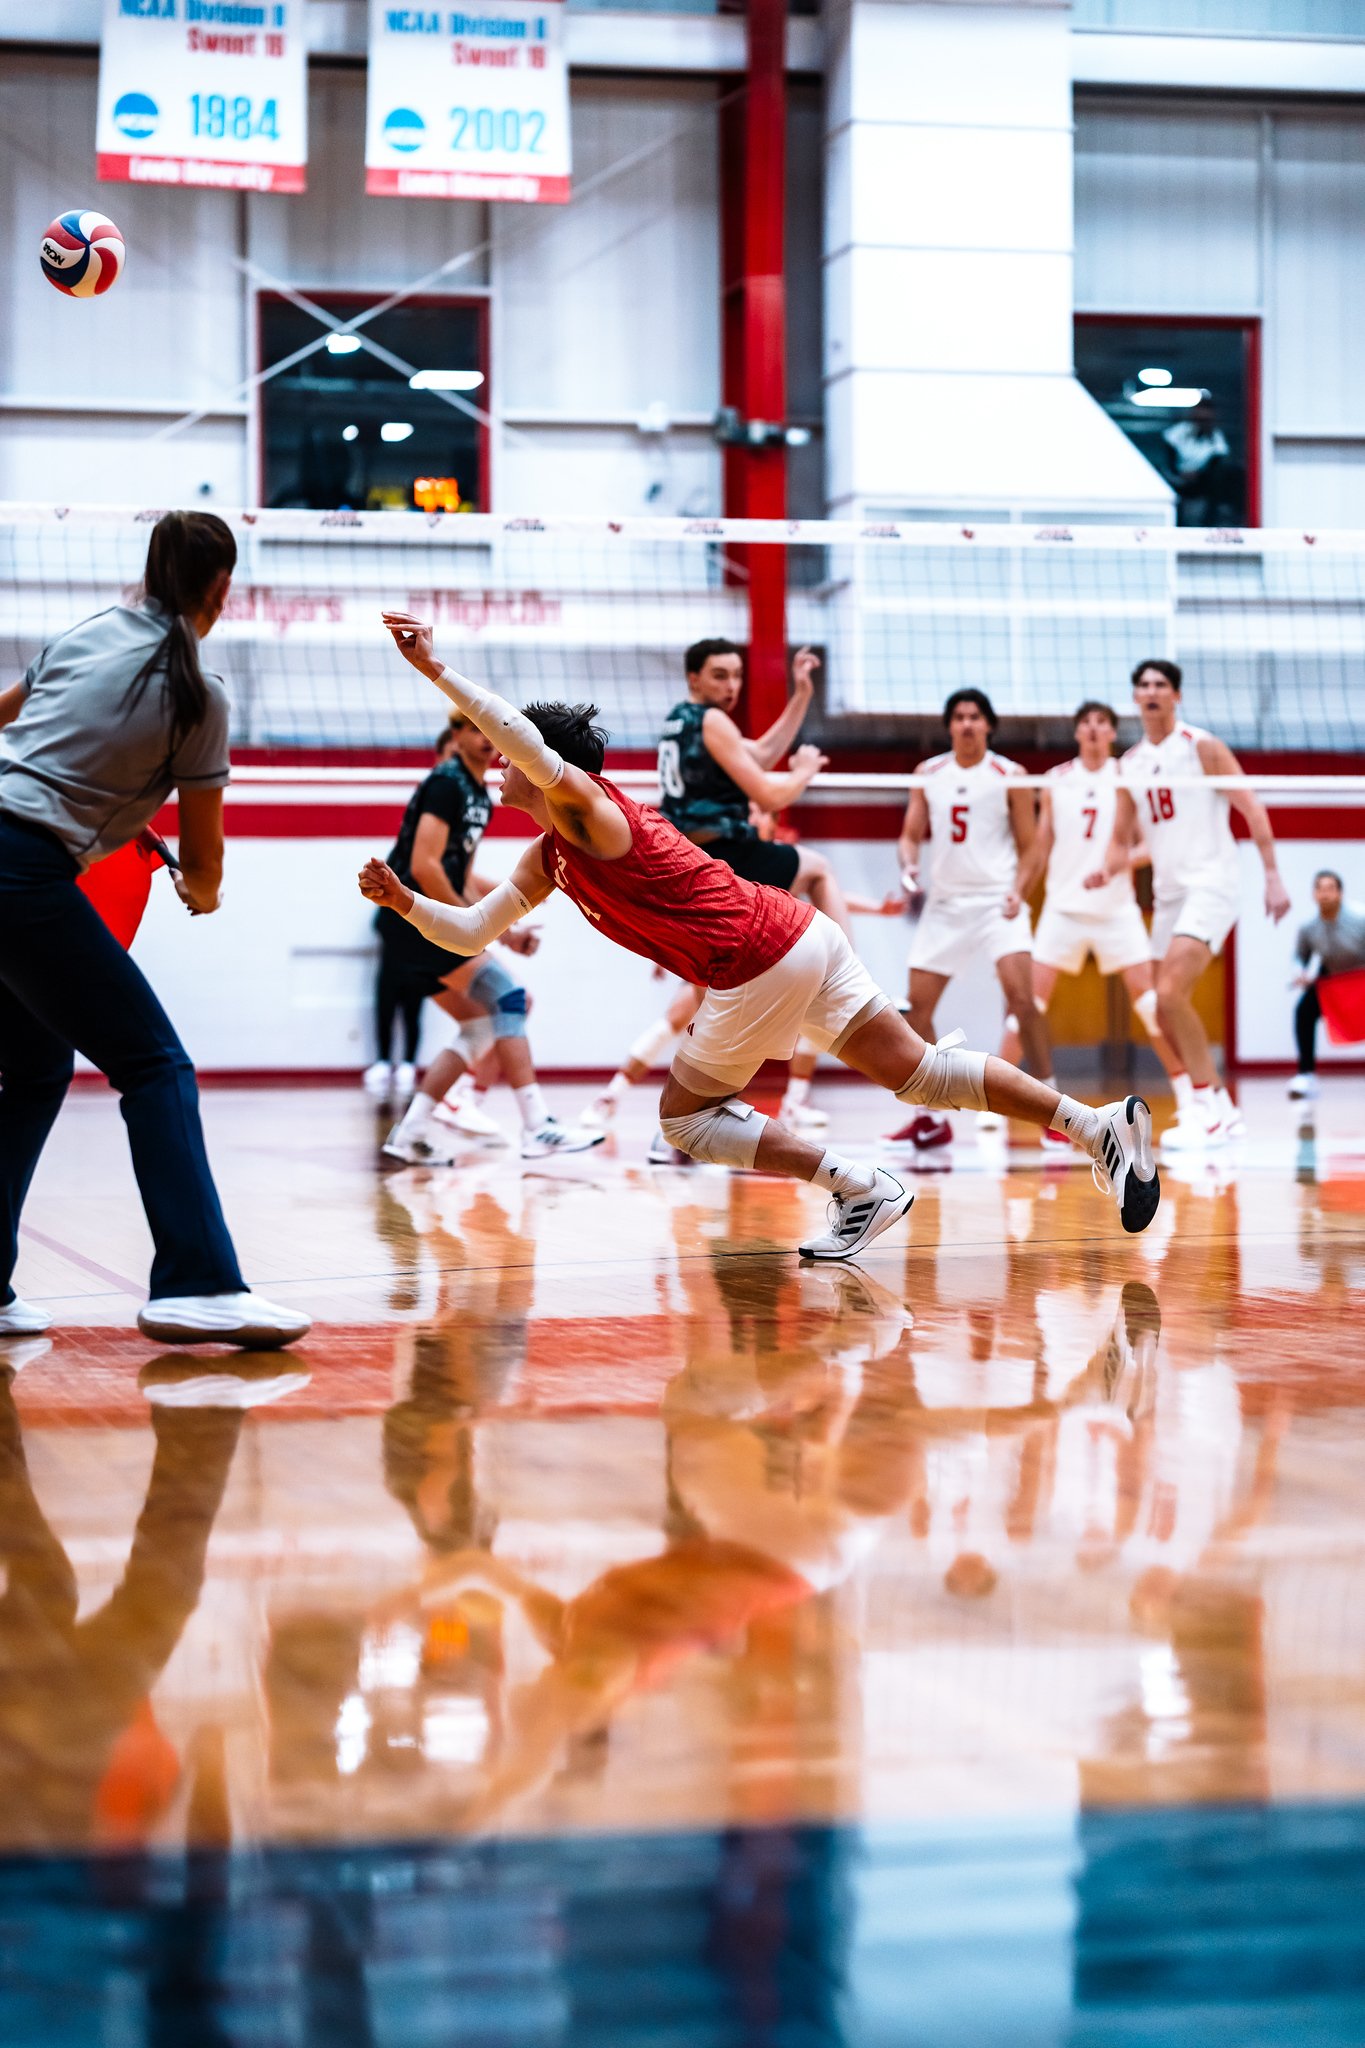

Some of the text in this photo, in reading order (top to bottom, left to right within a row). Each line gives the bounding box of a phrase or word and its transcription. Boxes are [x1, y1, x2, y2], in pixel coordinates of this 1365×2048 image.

[186, 0, 264, 25] Division
[452, 13, 526, 38] Division
[191, 94, 280, 140] 1984
[450, 107, 545, 153] 2002
[1146, 788, 1174, 823] 18
[951, 806, 969, 843] 5
[1082, 809, 1097, 839] 7
